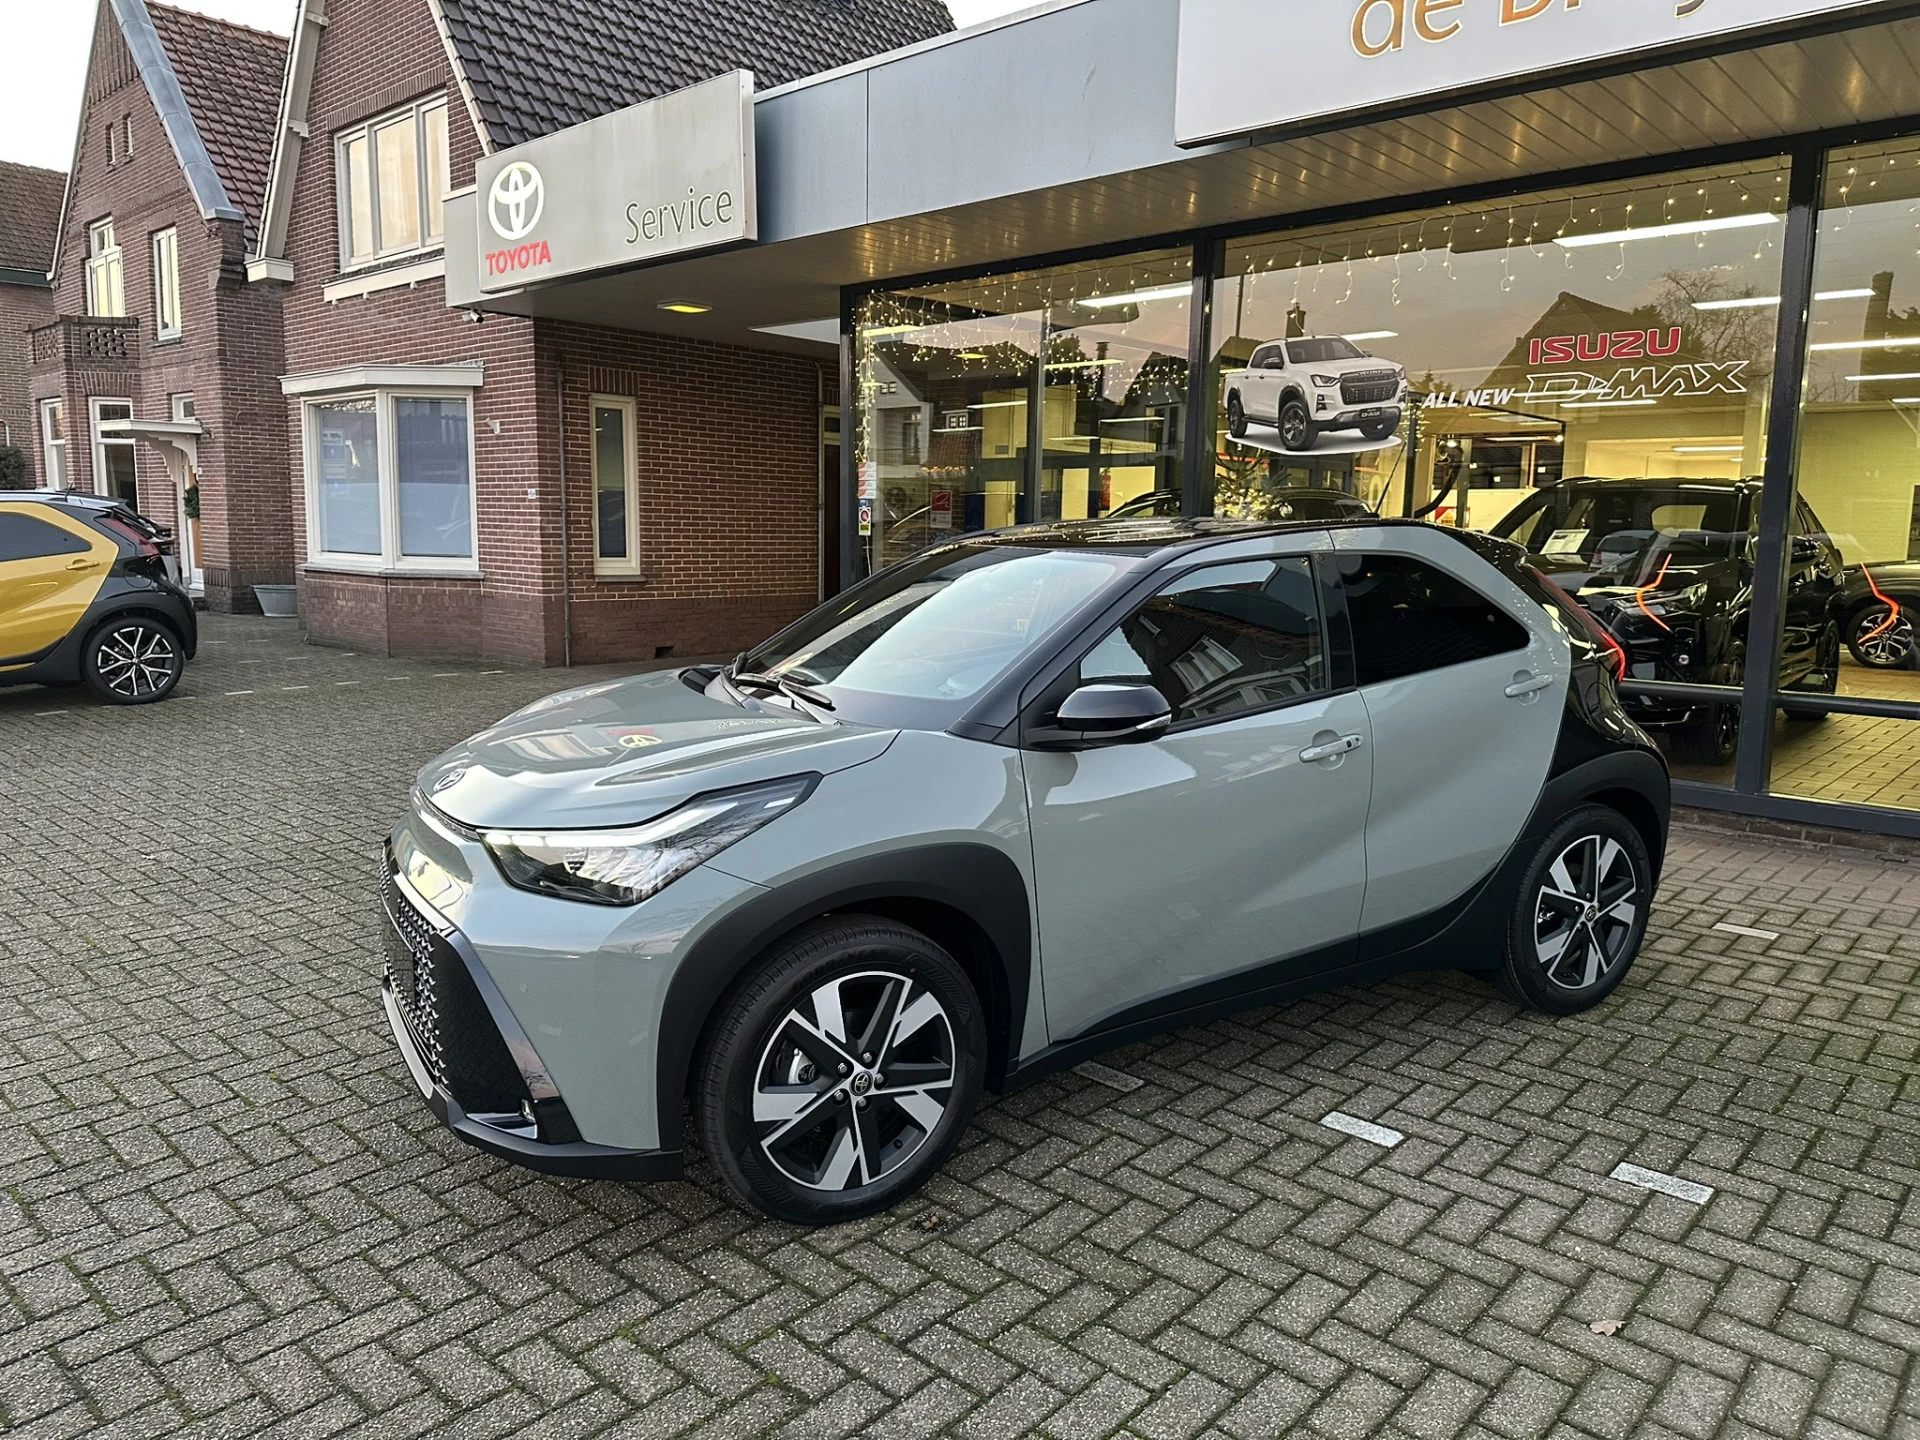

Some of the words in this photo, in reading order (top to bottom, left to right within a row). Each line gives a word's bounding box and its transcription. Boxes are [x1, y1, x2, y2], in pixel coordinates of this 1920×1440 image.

[624, 186, 734, 246] Service
[485, 240, 552, 276] TOYOTA
[1528, 326, 1682, 365] ISUZU
[1421, 391, 1463, 409] ALL
[1465, 387, 1516, 408] NEW
